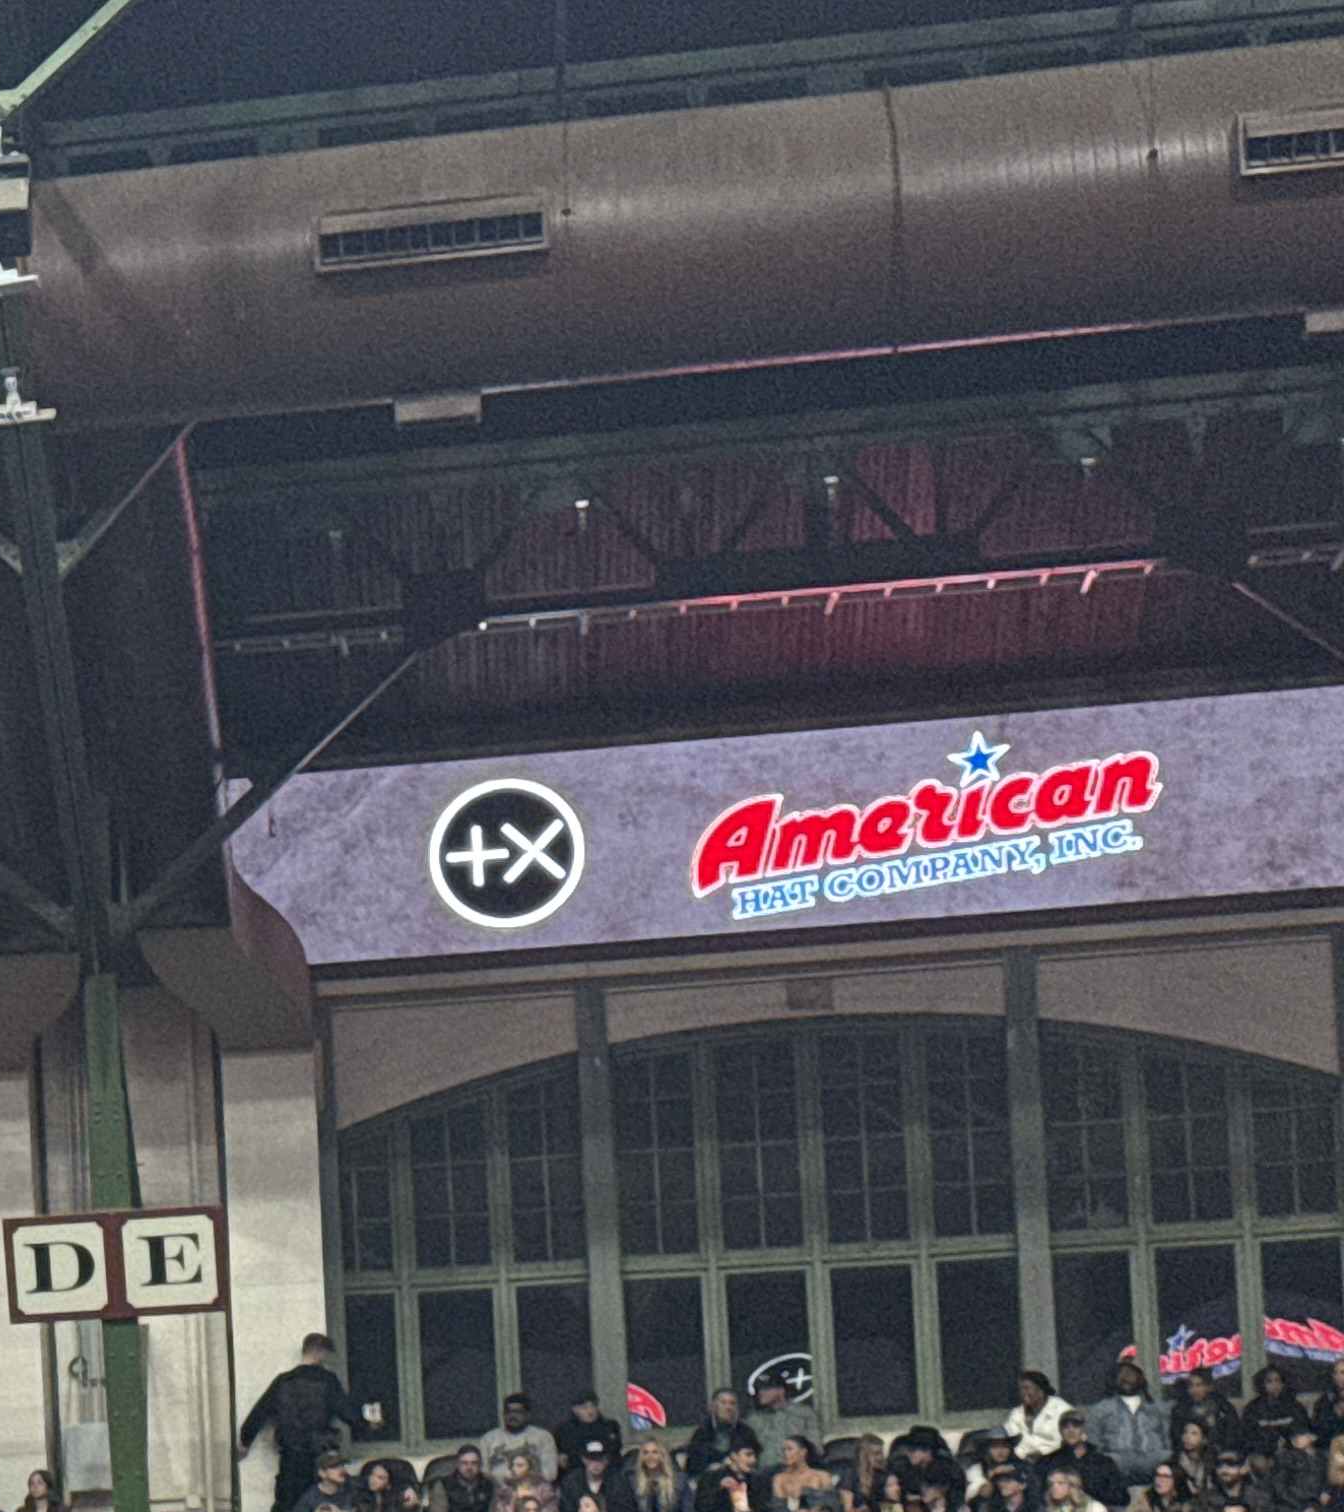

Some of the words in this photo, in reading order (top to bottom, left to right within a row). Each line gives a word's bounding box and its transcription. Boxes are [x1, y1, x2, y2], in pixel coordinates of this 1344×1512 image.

[692, 750, 1163, 898] American
[733, 876, 818, 920] HAT
[823, 835, 1047, 904] COMPANY,
[1049, 820, 1144, 863] INC.
[23, 1241, 95, 1294] D
[136, 1233, 202, 1286] E
